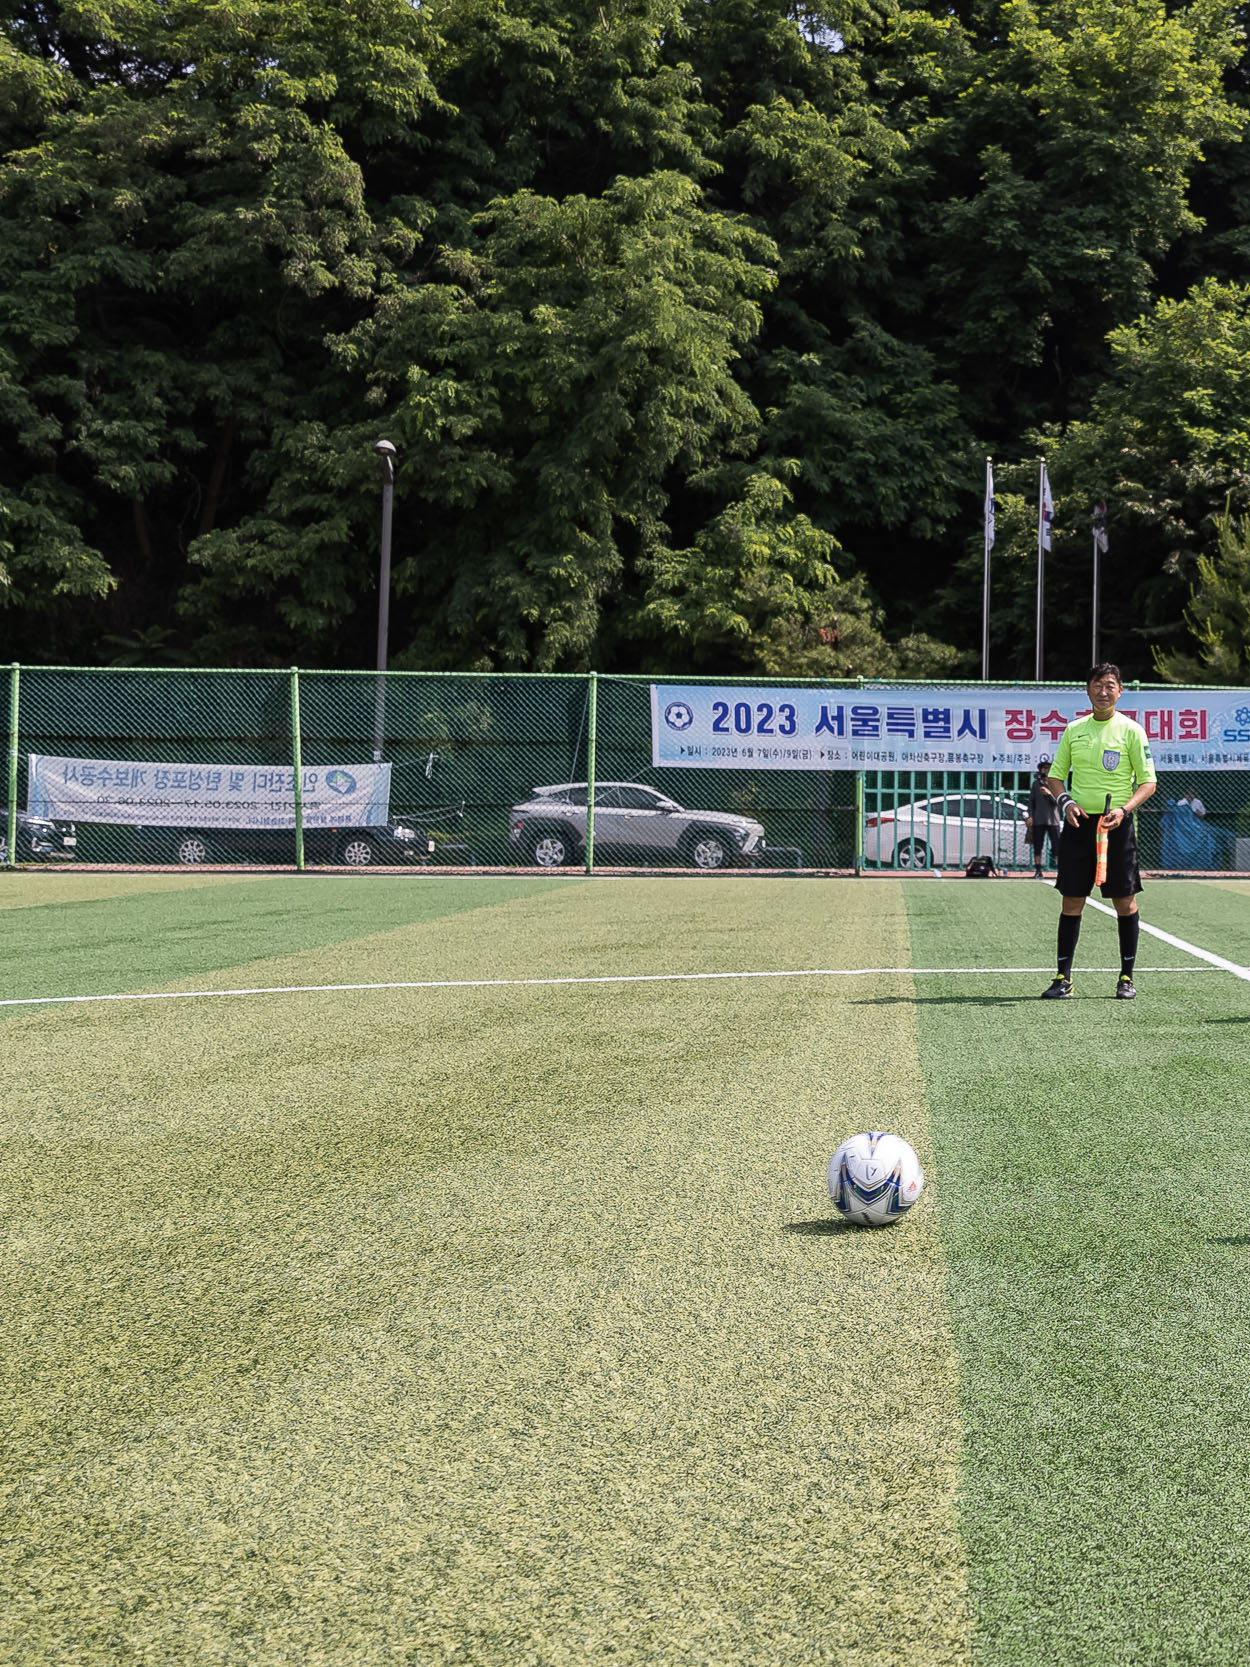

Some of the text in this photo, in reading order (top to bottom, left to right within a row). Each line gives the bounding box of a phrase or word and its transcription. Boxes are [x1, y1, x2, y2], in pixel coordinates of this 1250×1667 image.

[712, 701, 1207, 741] 2023 서울특별시 장수대회
[687, 745, 702, 757] 일시
[712, 746, 738, 758] 2023년
[741, 747, 754, 758] 6월
[827, 750, 841, 761] 장소
[998, 752, 1031, 765] 주최/주관
